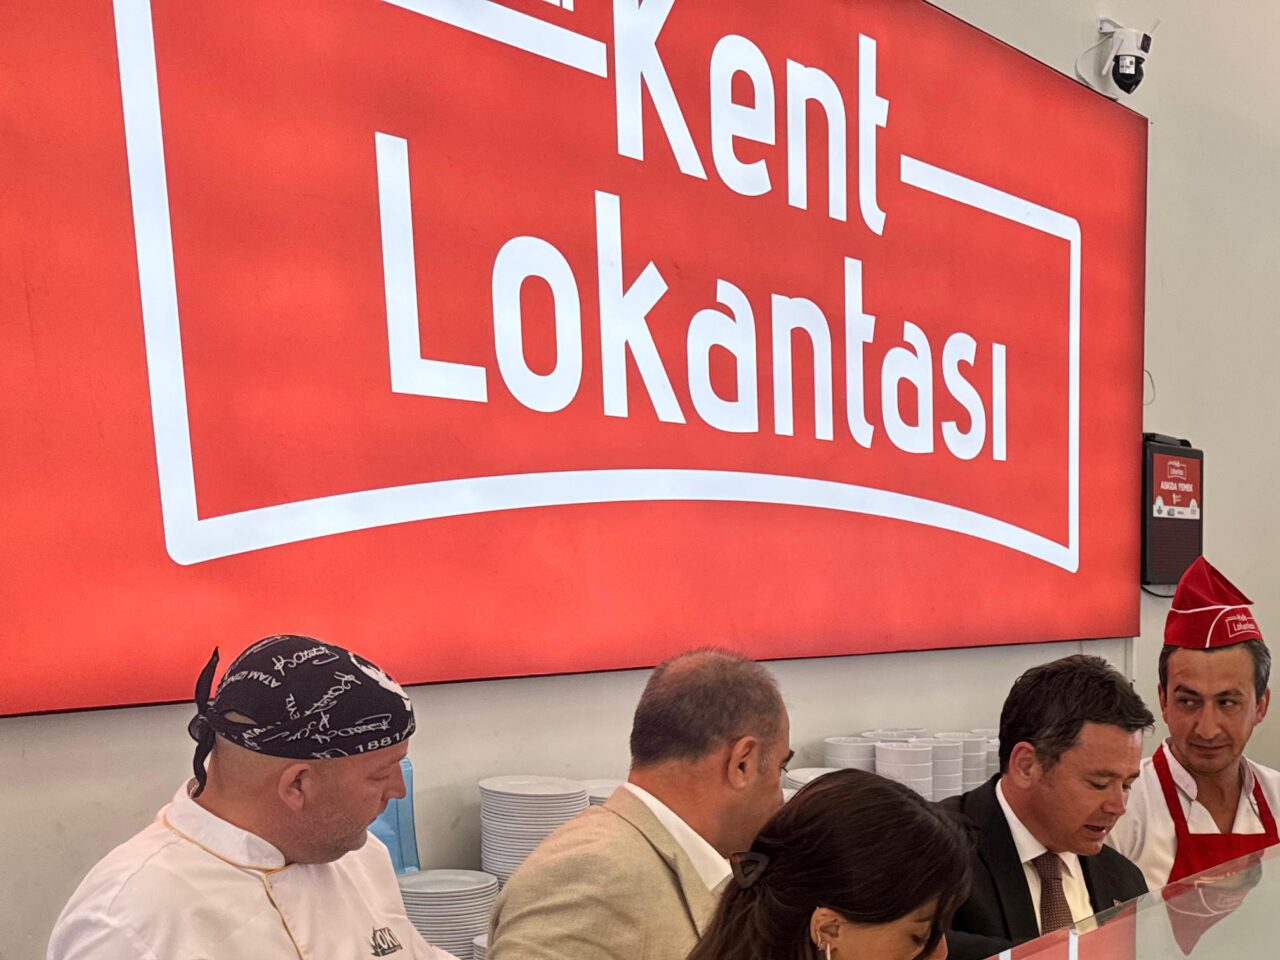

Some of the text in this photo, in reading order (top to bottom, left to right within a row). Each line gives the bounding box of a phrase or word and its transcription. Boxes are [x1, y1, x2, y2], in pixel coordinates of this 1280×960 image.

[613, 0, 889, 236] Kent
[375, 131, 1007, 461] Lokantası
[355, 732, 402, 754] 1881
